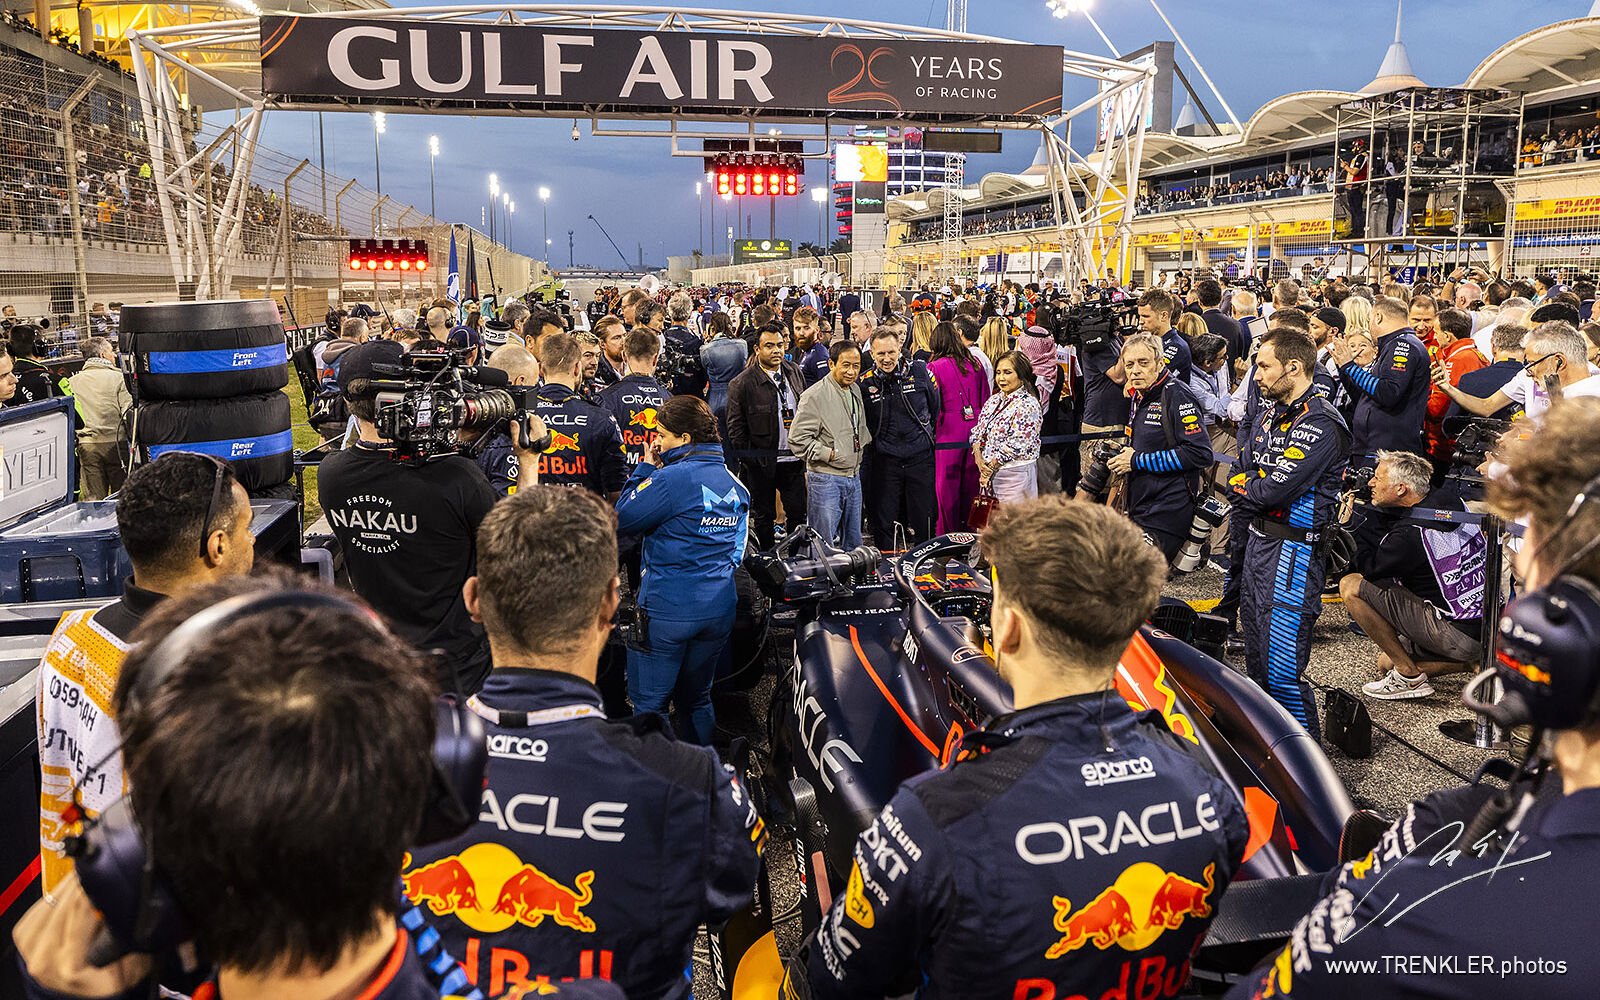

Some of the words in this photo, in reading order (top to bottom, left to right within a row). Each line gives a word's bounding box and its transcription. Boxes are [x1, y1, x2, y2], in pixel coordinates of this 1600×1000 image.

[327, 26, 594, 96] GULF
[619, 35, 774, 103] AIR
[910, 55, 1004, 81] YEARS
[916, 86, 936, 98] OF
[940, 86, 998, 99] RACING
[1300, 220, 1327, 232] DHL
[232, 358, 252, 367] Left
[233, 352, 258, 360] Front
[231, 449, 251, 457] Left
[232, 442, 255, 450] Rear
[4, 436, 57, 494] YETI
[550, 456, 588, 475] Bull
[346, 494, 393, 508] FREEDOM
[330, 508, 418, 534] NAKAU
[351, 537, 400, 554] SPECIALIST
[864, 606, 902, 615] JEANS
[1081, 756, 1154, 784] sparco
[1014, 793, 1221, 865] ORACLE
